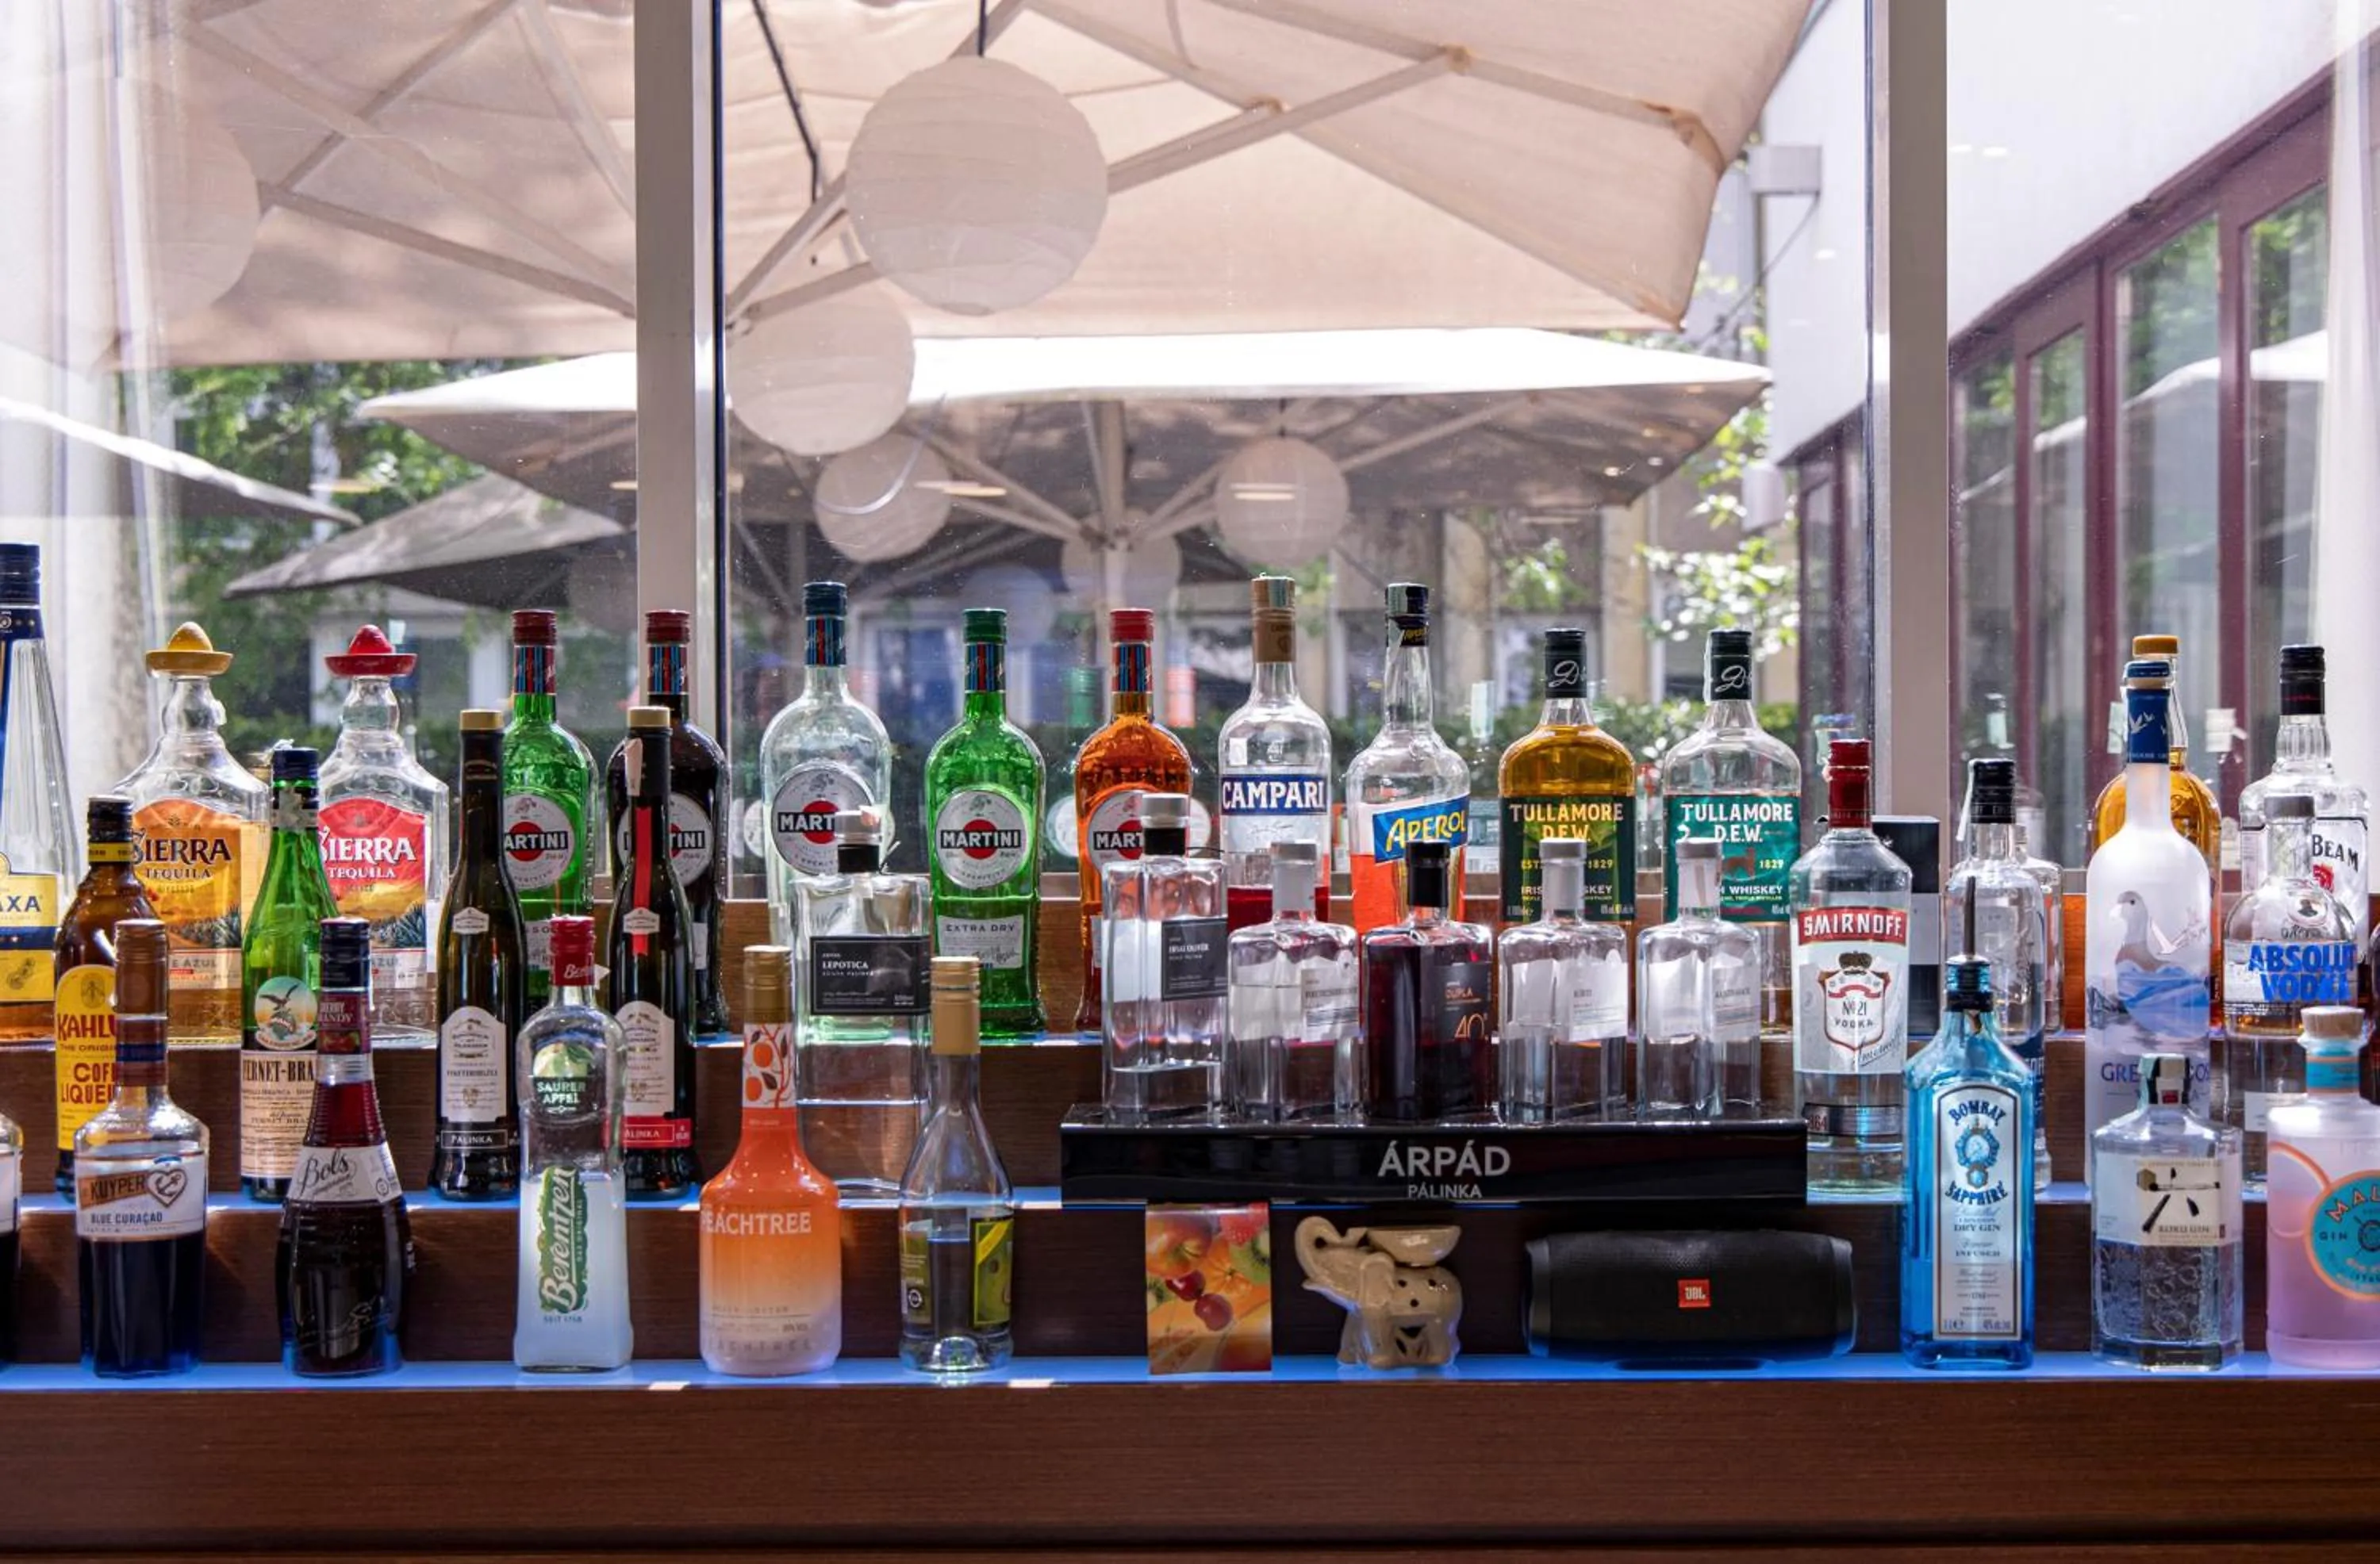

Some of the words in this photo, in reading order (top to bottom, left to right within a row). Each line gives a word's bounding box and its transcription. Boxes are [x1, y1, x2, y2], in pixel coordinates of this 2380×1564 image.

[1223, 780, 1325, 809] CAMPARI
[1510, 803, 1624, 822] TULLAMORE
[1680, 803, 1794, 822] TULLAMORE
[780, 814, 834, 831] MART
[1386, 810, 1466, 853] APEROL
[504, 831, 568, 851] ARTINI
[670, 831, 704, 849] TINI
[942, 830, 1020, 849] MARTINI
[1096, 833, 1144, 849] MART
[1714, 824, 1763, 842] D.E.W.
[132, 828, 232, 864] SIERRA
[319, 826, 416, 864] SIERRA
[2312, 834, 2359, 873] BEAM
[146, 868, 212, 879] TEQUILA
[328, 867, 397, 879] TEQUILA
[1759, 860, 1784, 870] 1829
[1521, 885, 1543, 896] IRIS
[1729, 885, 1783, 895] WHISKEY
[946, 924, 985, 933] EXTRA
[991, 923, 1015, 933] DRY
[1803, 912, 1903, 937] SMIRNOFF
[822, 960, 869, 970] LEPOTICA
[2248, 944, 2357, 973] ABSOLUT
[2259, 972, 2351, 1002] VODKA
[1857, 1001, 1867, 1016] 21
[1834, 1018, 1874, 1029] VODKA
[80, 1044, 115, 1052] ORIGI
[243, 1060, 315, 1083] FERNET-BRA
[2101, 1062, 2140, 1083] GRE
[61, 1083, 113, 1105] LIQUEU
[536, 1080, 585, 1093] SAURER
[1948, 1100, 2006, 1126] BOMBAY
[1377, 1140, 1511, 1177] ÁRPÁD
[297, 1149, 350, 1198] Bols
[90, 1175, 146, 1201] KUYPER
[1408, 1181, 1483, 1200] PÁLINKA
[1944, 1180, 2008, 1206] SAPPHIRE
[2325, 1185, 2380, 1222] MAL
[91, 1213, 112, 1224] BLUE
[115, 1211, 163, 1225] CURAÇAO
[541, 1167, 577, 1312] Berentzen
[2319, 1232, 2347, 1240] GIN
[1684, 1286, 1706, 1300] JBL
